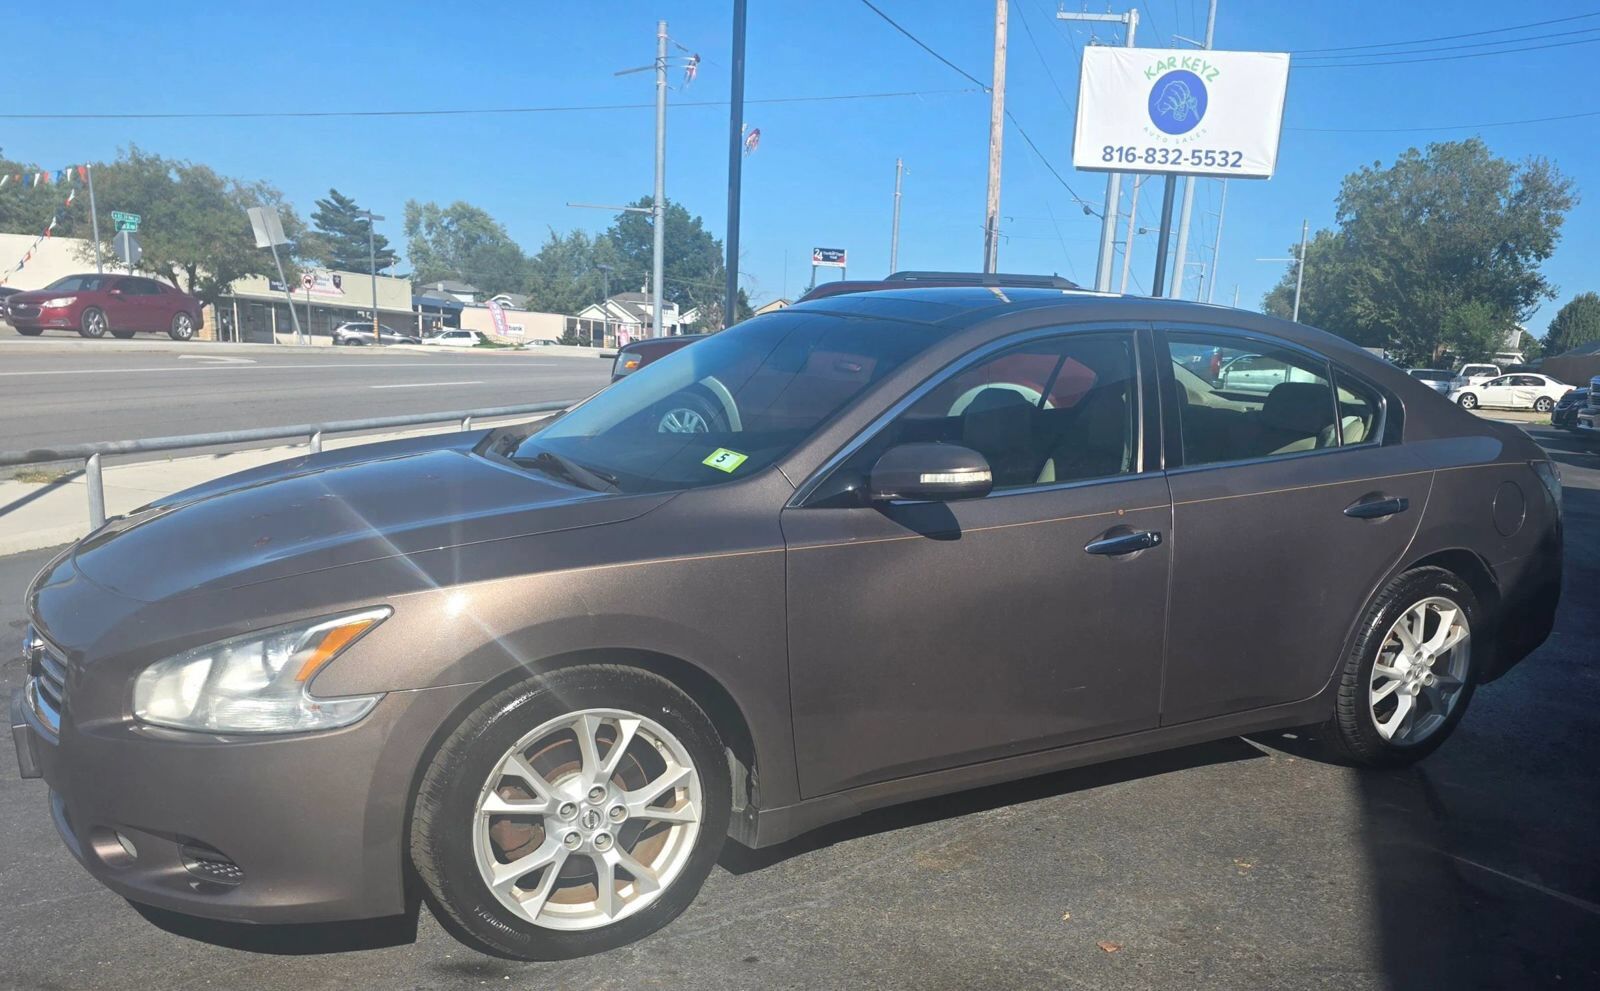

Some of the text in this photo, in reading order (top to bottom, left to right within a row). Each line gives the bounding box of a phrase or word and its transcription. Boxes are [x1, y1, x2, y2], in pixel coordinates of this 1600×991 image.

[1143, 56, 1220, 82] KAR KEYZ
[1143, 126, 1168, 143] AUTO
[1101, 145, 1243, 168] 816-832-5532
[715, 453, 730, 463] 5
